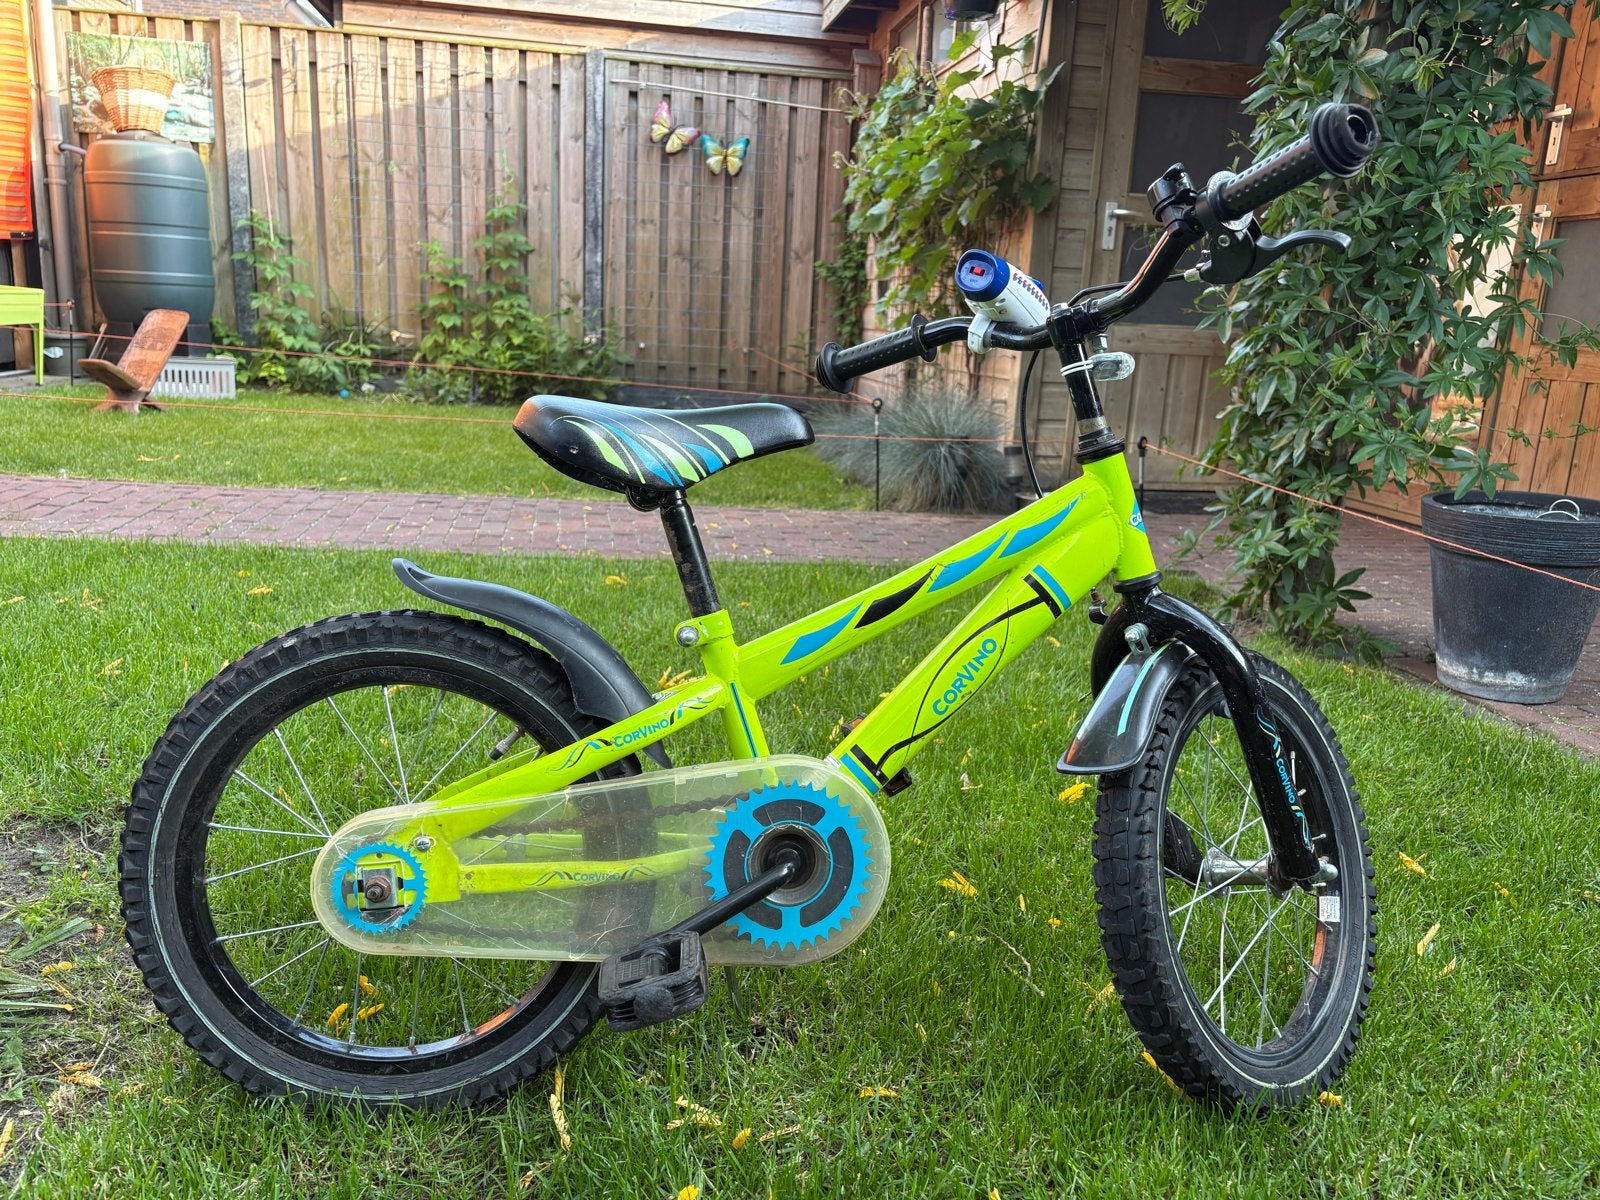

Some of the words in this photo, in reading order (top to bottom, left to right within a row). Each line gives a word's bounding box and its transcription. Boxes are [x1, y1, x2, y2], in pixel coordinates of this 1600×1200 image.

[932, 638, 997, 715] CORVINO
[613, 718, 669, 747] CORVINO
[1276, 758, 1295, 803] CORVINO
